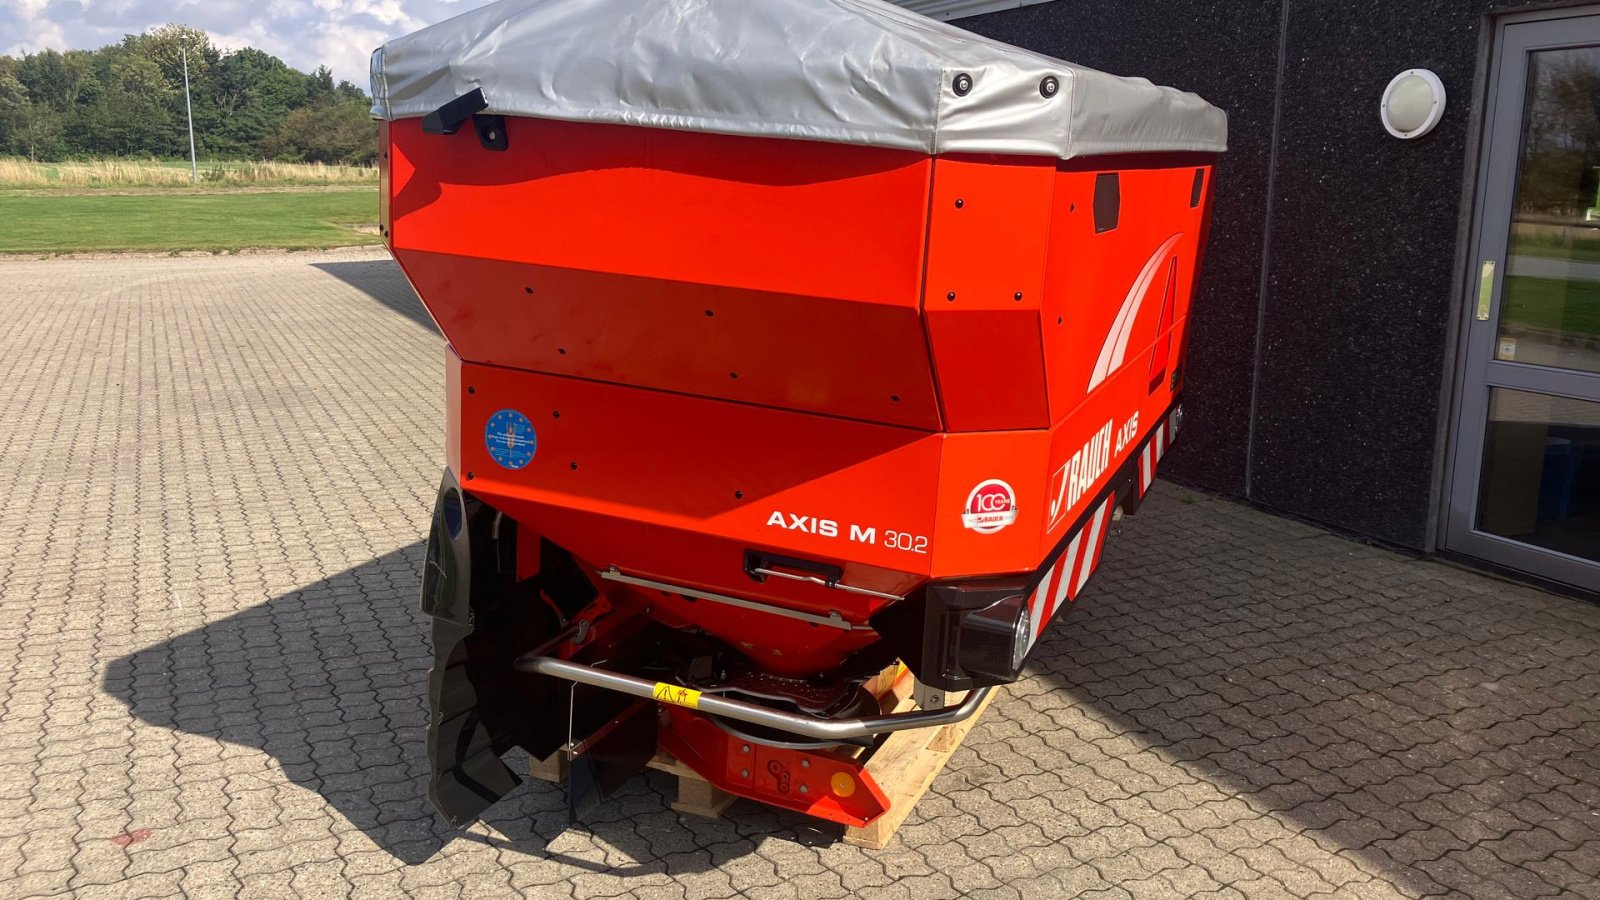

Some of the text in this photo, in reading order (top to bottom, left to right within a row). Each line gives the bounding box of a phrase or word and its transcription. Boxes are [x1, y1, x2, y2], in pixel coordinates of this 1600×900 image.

[1067, 410, 1139, 512] RAUCH AXIS
[976, 493, 1006, 513] 100
[766, 511, 928, 554] AXIS M 30.2
